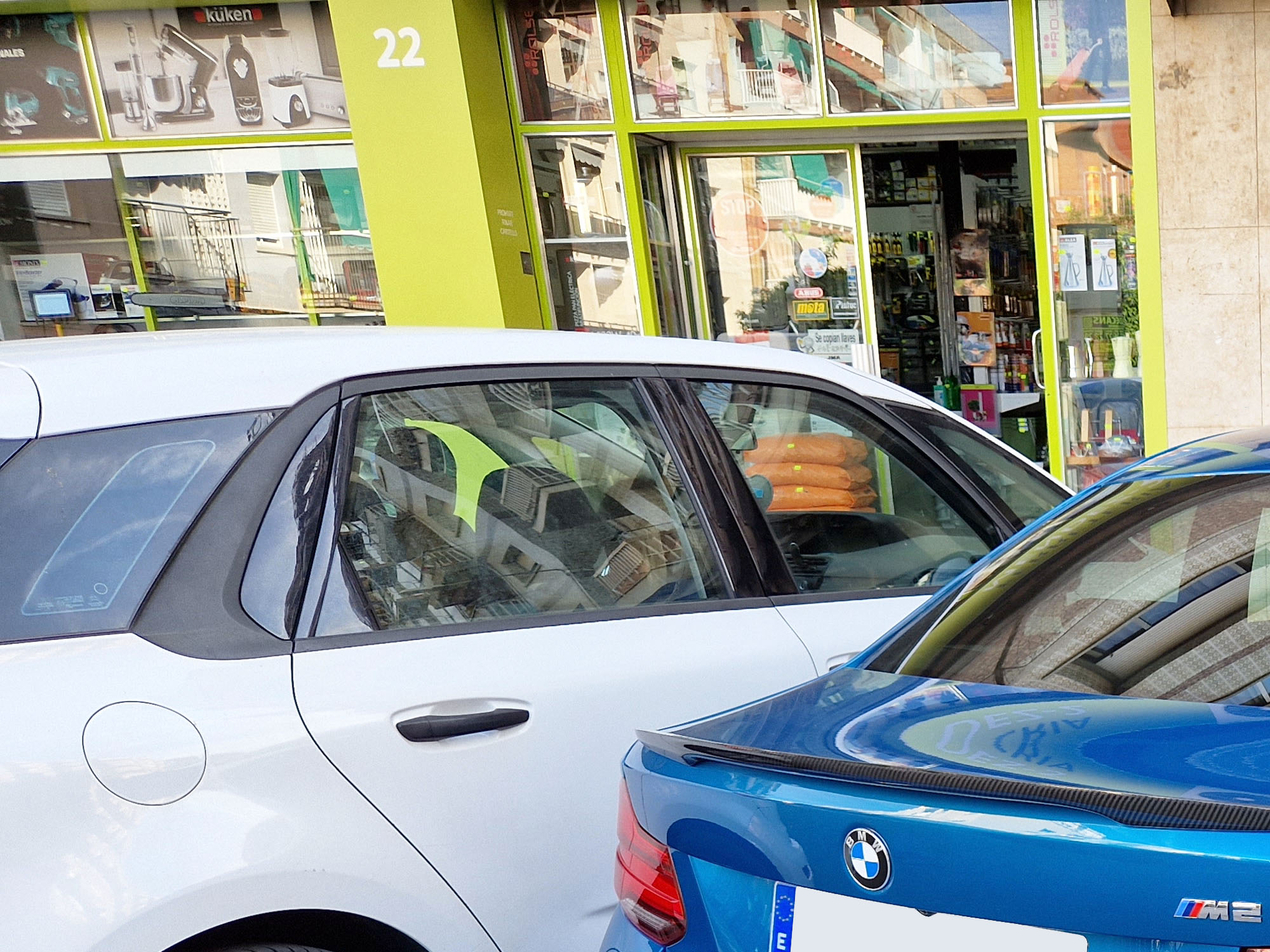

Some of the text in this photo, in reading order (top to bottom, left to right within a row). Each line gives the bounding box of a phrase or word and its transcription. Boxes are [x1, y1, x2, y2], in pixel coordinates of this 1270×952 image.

[205, 7, 253, 23] küken
[373, 26, 425, 68] 22
[720, 200, 755, 215] STOP
[797, 302, 825, 314] mota
[846, 831, 883, 852] BMW
[1197, 899, 1262, 923] M2
[777, 932, 787, 950] E
